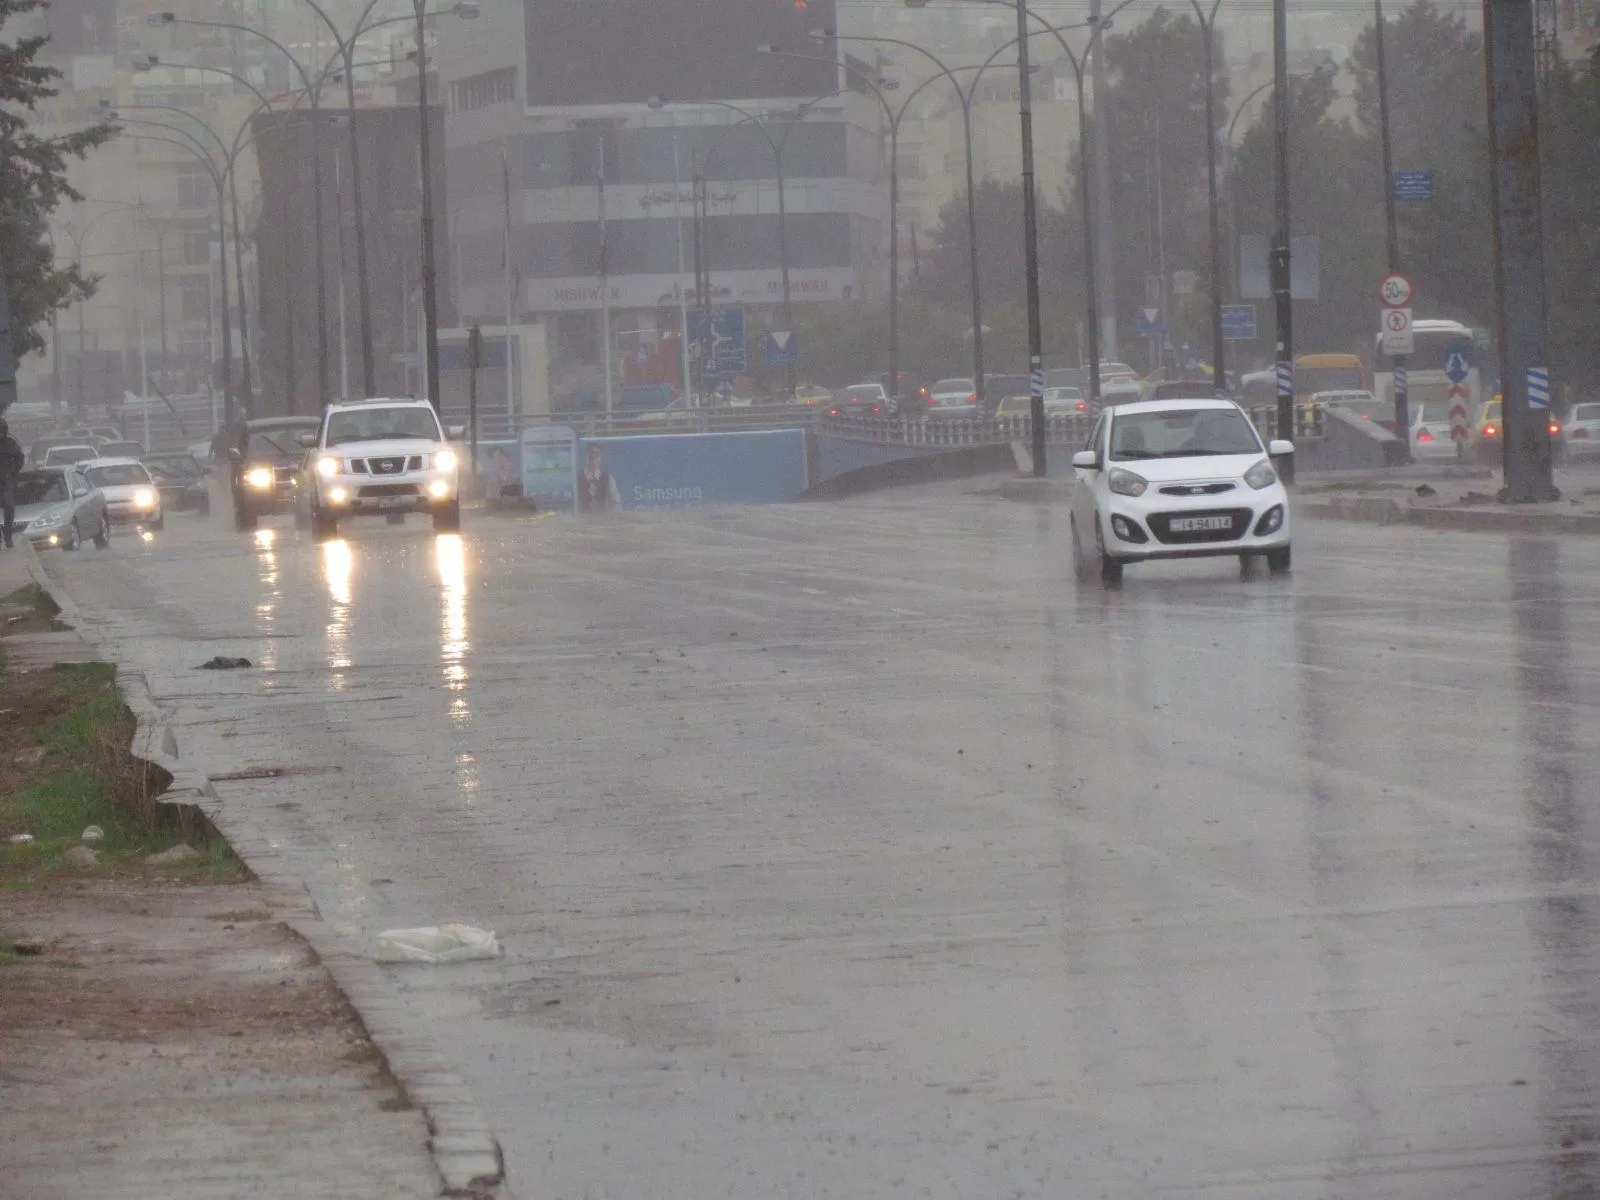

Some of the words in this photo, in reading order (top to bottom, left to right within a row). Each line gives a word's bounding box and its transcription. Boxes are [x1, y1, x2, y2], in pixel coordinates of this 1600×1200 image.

[553, 287, 621, 301] MISHWR
[767, 279, 831, 294] MIHWAR
[1386, 281, 1399, 298] 50
[633, 484, 702, 501] Samsung
